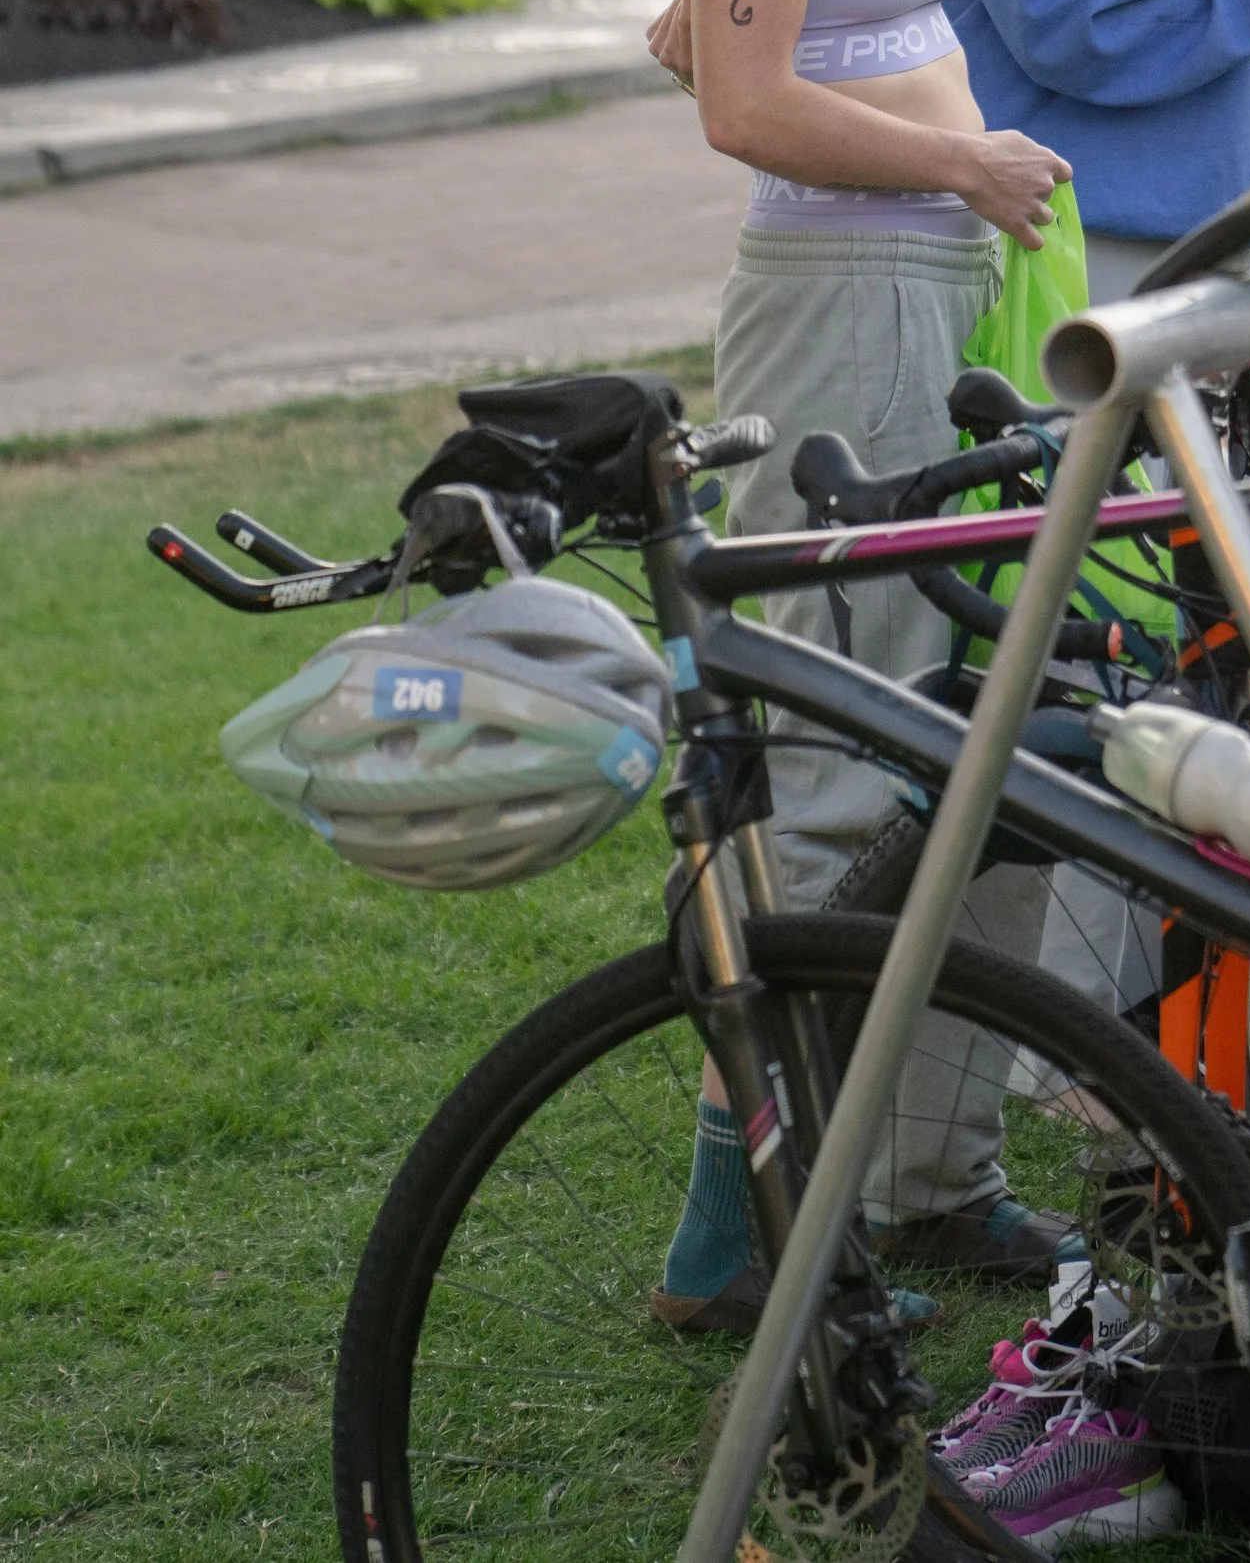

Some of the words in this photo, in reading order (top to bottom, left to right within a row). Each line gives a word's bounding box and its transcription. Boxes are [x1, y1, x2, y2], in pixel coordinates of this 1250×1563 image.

[795, 38, 834, 71] E
[841, 23, 926, 67] PRO
[392, 677, 446, 712] 942
